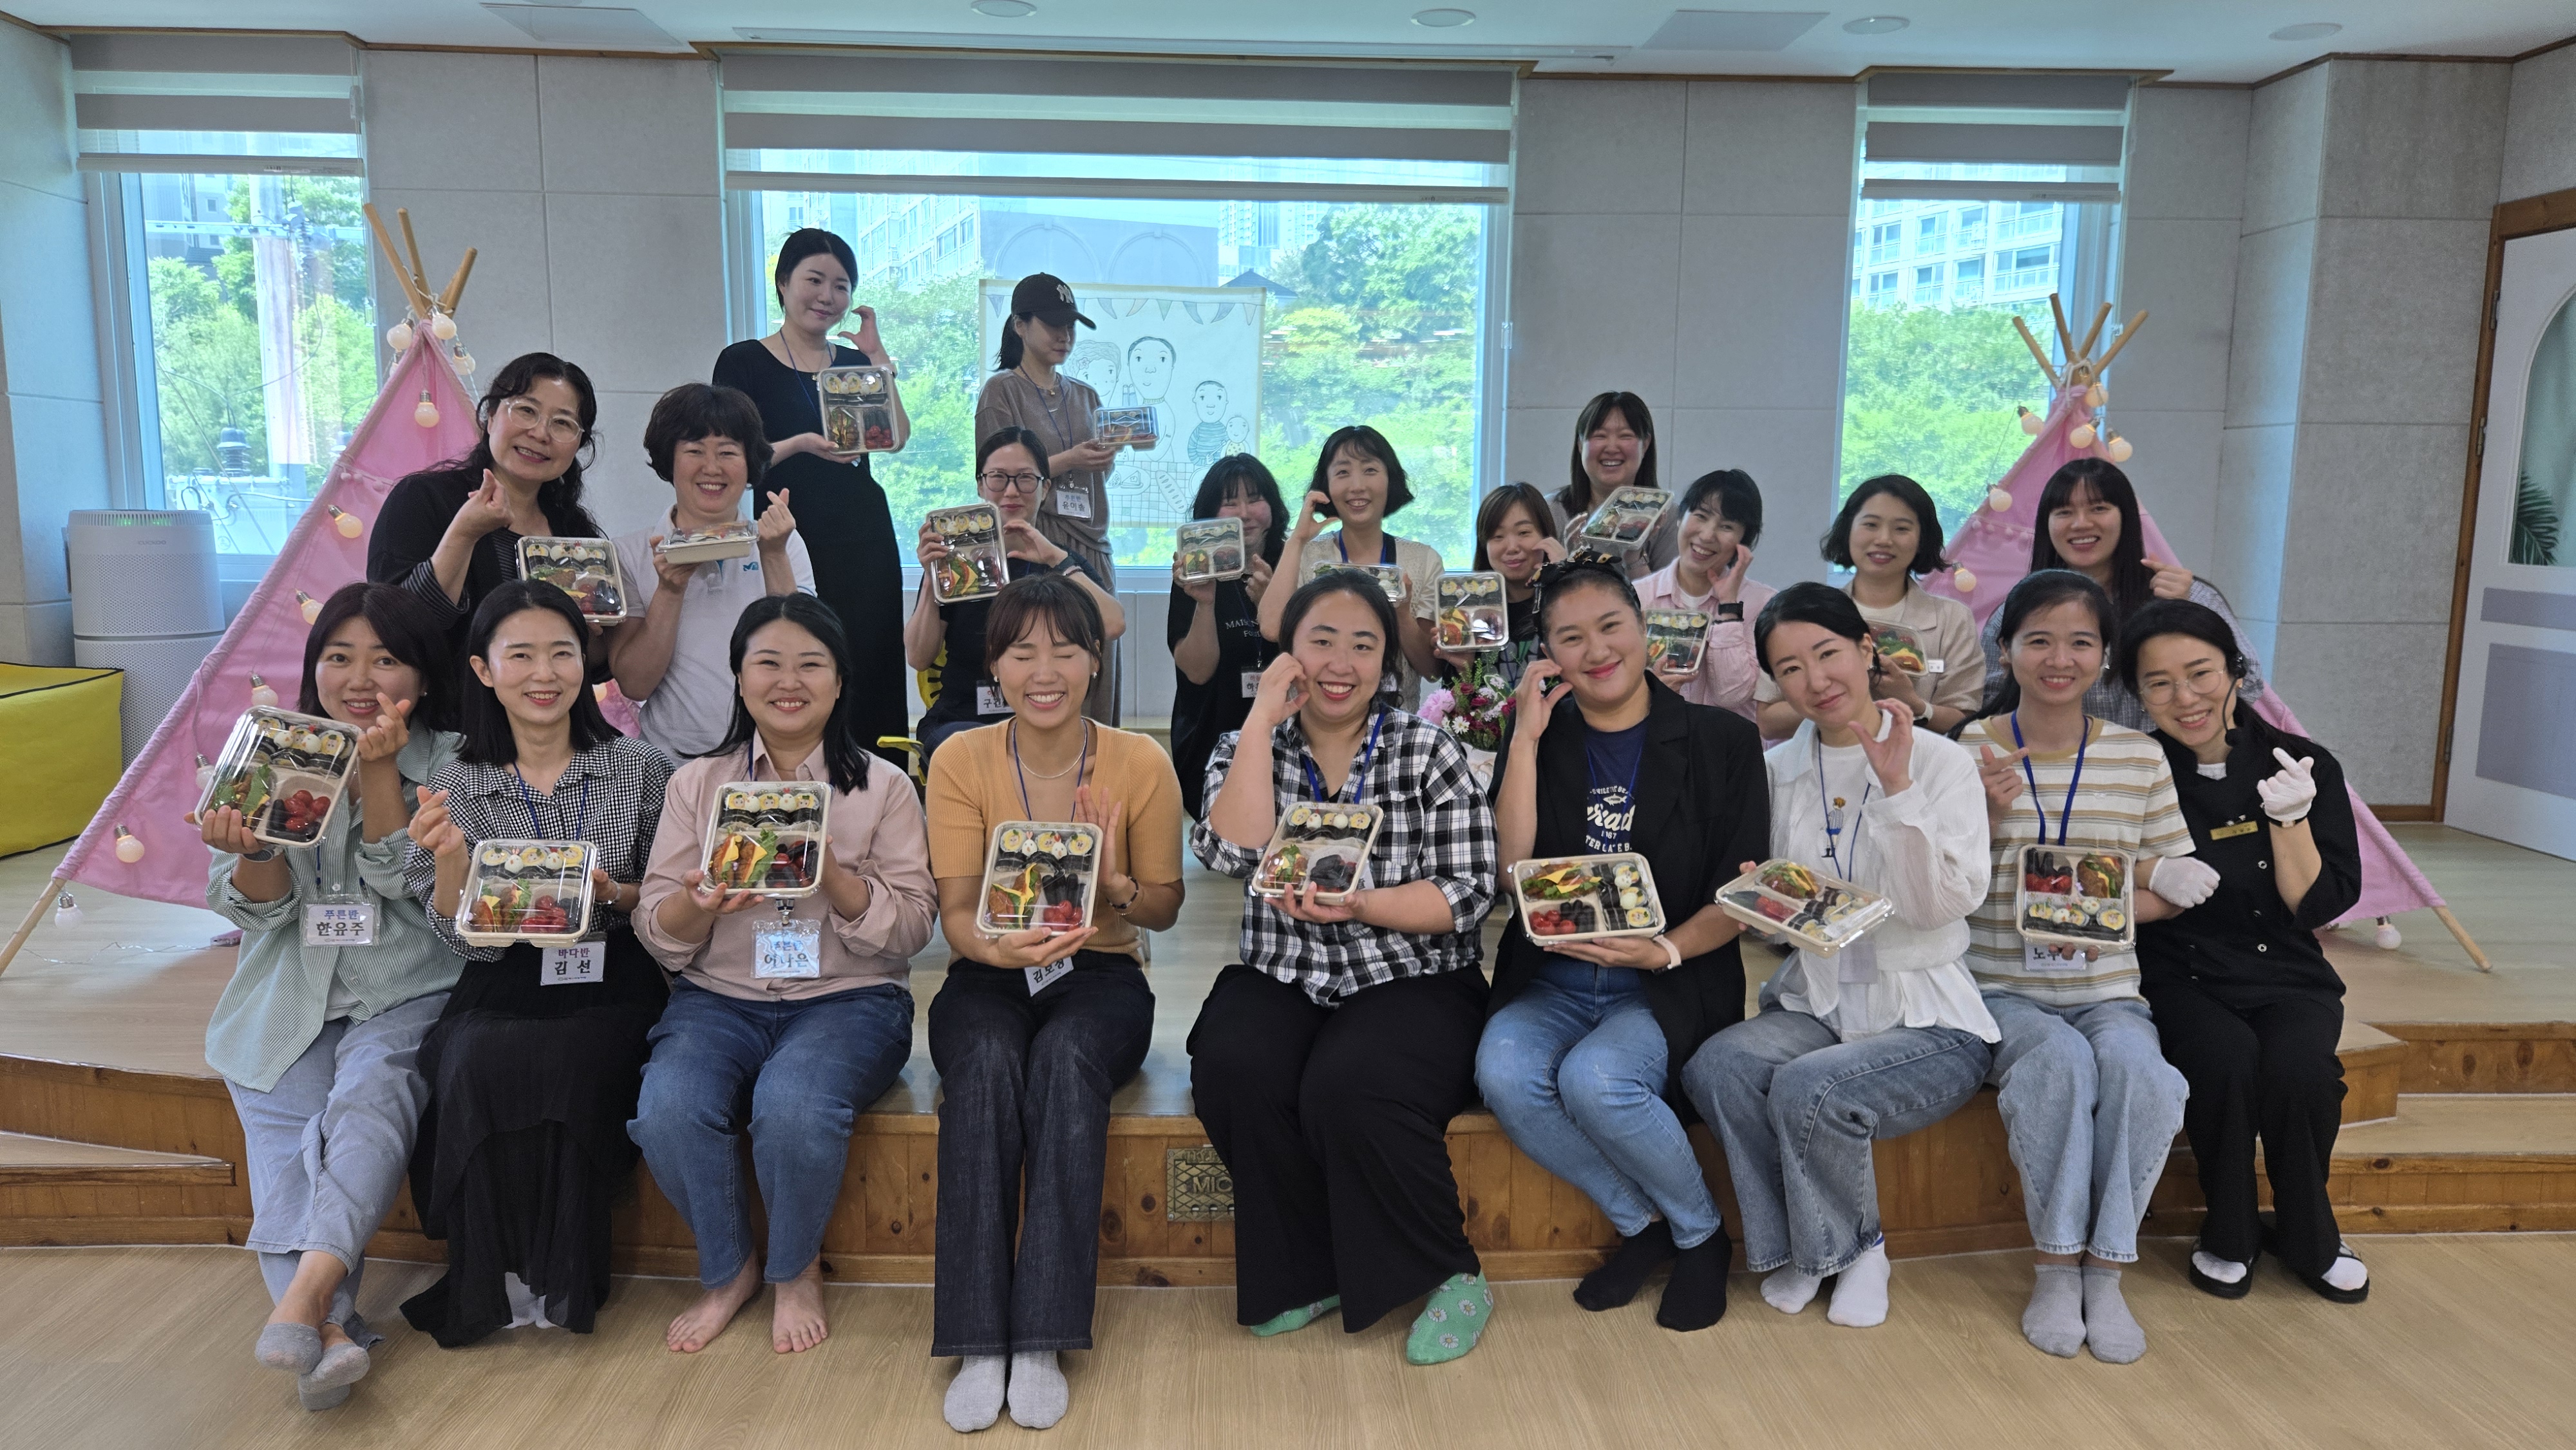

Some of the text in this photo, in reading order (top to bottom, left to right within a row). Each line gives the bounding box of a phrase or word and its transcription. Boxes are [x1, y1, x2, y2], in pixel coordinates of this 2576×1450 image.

[325, 910, 358, 920] 푸른반
[316, 921, 365, 936] 한유주
[558, 947, 591, 959] 바다반
[764, 953, 809, 968] 이나은
